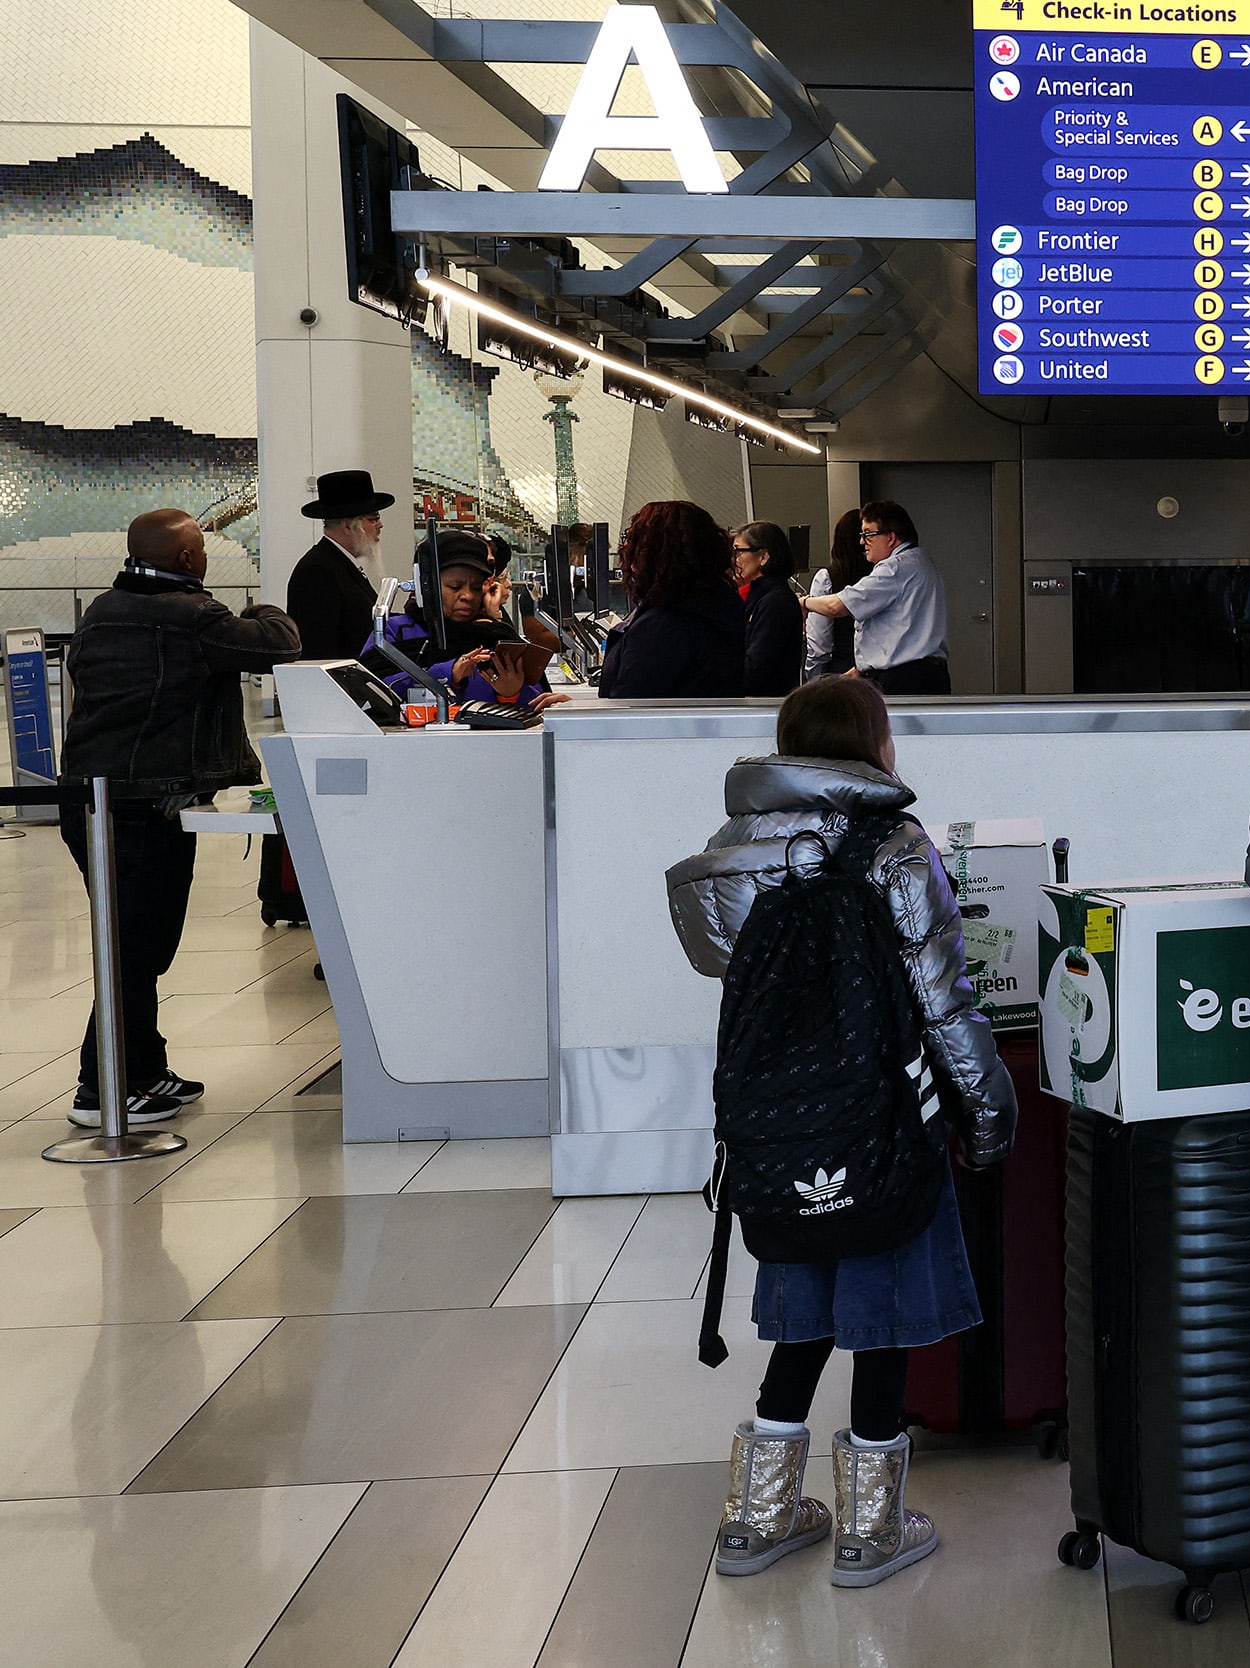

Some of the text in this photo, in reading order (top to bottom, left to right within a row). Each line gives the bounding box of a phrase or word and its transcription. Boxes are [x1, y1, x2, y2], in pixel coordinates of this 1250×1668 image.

[1043, 2, 1237, 22] Check-in Locations
[1037, 44, 1147, 63] Air Canada
[1201, 47, 1211, 62] E
[1037, 79, 1133, 97] American
[539, 4, 729, 194] A
[1054, 111, 1129, 127] Priority &
[1054, 130, 1179, 146] Special Services
[1200, 122, 1214, 138] A
[1055, 165, 1128, 182] Bag Drop
[1202, 166, 1213, 182] B
[1055, 198, 1128, 215] Bag Drop
[1202, 198, 1213, 215] C
[1038, 232, 1119, 249] Frontier
[1201, 234, 1214, 250] H
[1038, 264, 1112, 283] JetBlue
[1203, 267, 1216, 283] D
[1039, 297, 1103, 314] Porter
[1203, 299, 1216, 314] D
[1040, 329, 1150, 348] Southwest
[1202, 330, 1216, 347] G
[1040, 361, 1108, 379] United
[1204, 362, 1214, 378] F
[993, 1010, 1036, 1022] Lakewood
[799, 1196, 854, 1216] adidas
